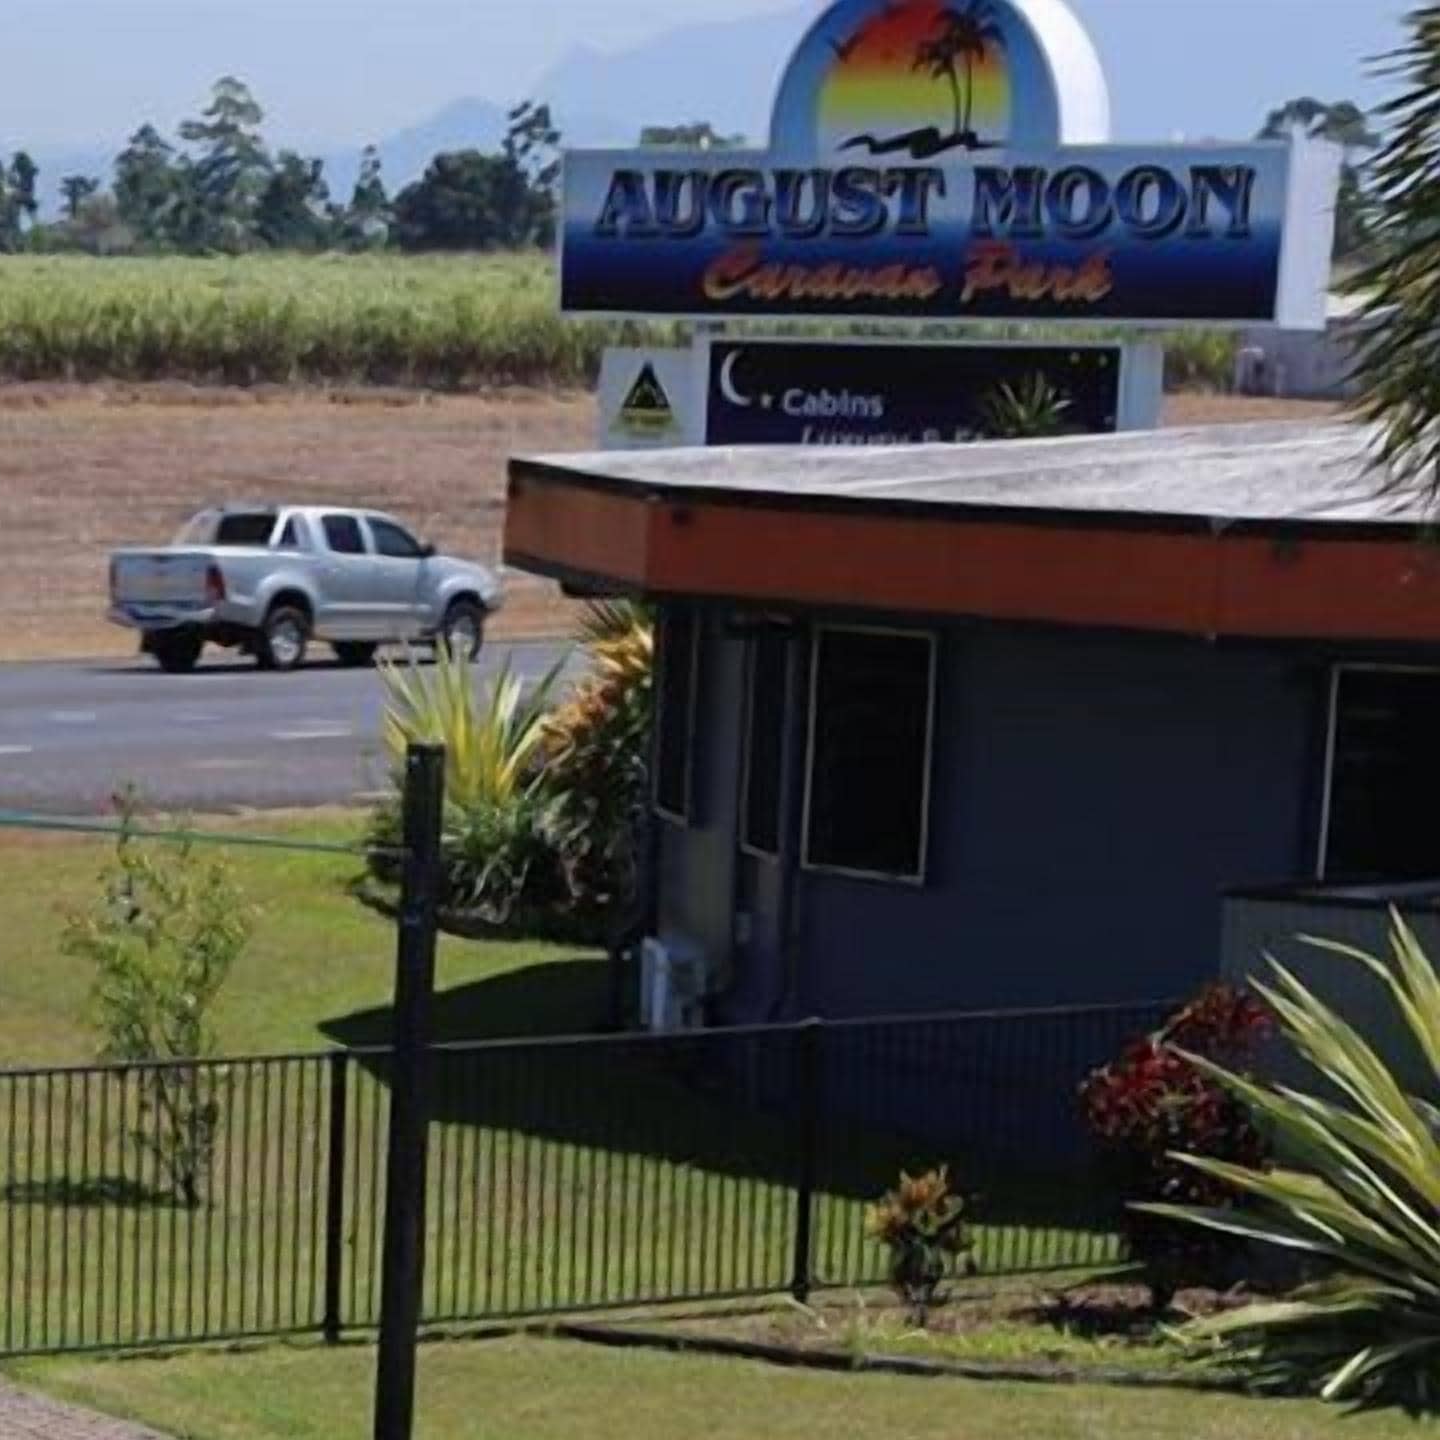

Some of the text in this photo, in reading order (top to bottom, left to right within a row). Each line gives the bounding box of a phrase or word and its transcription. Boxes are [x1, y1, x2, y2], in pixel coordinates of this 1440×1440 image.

[596, 165, 1255, 240] AUGUST MOON
[703, 240, 1113, 301] Caravan Park
[783, 387, 884, 417] Cabins
